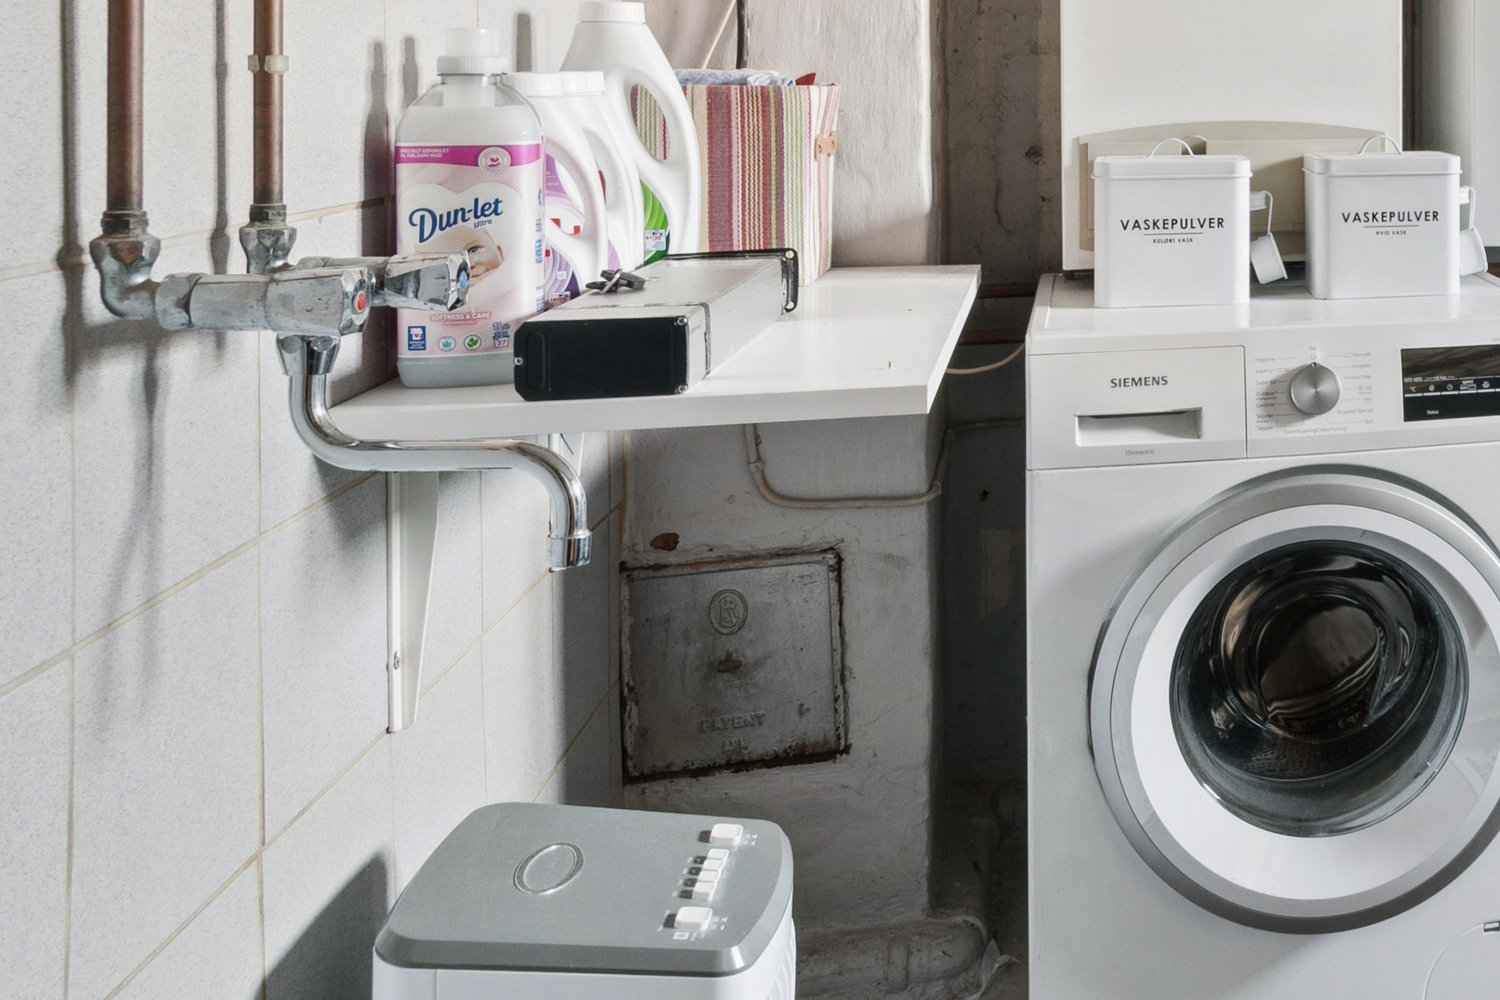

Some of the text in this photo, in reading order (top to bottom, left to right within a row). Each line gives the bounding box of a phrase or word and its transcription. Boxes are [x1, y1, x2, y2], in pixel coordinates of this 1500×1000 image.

[408, 197, 504, 243] Dun-let
[473, 218, 493, 229] Ultra
[1341, 210, 1440, 223] VASKEPULVER
[1120, 217, 1225, 231] VASKEPULVER
[1110, 375, 1168, 389] SIEMENS
